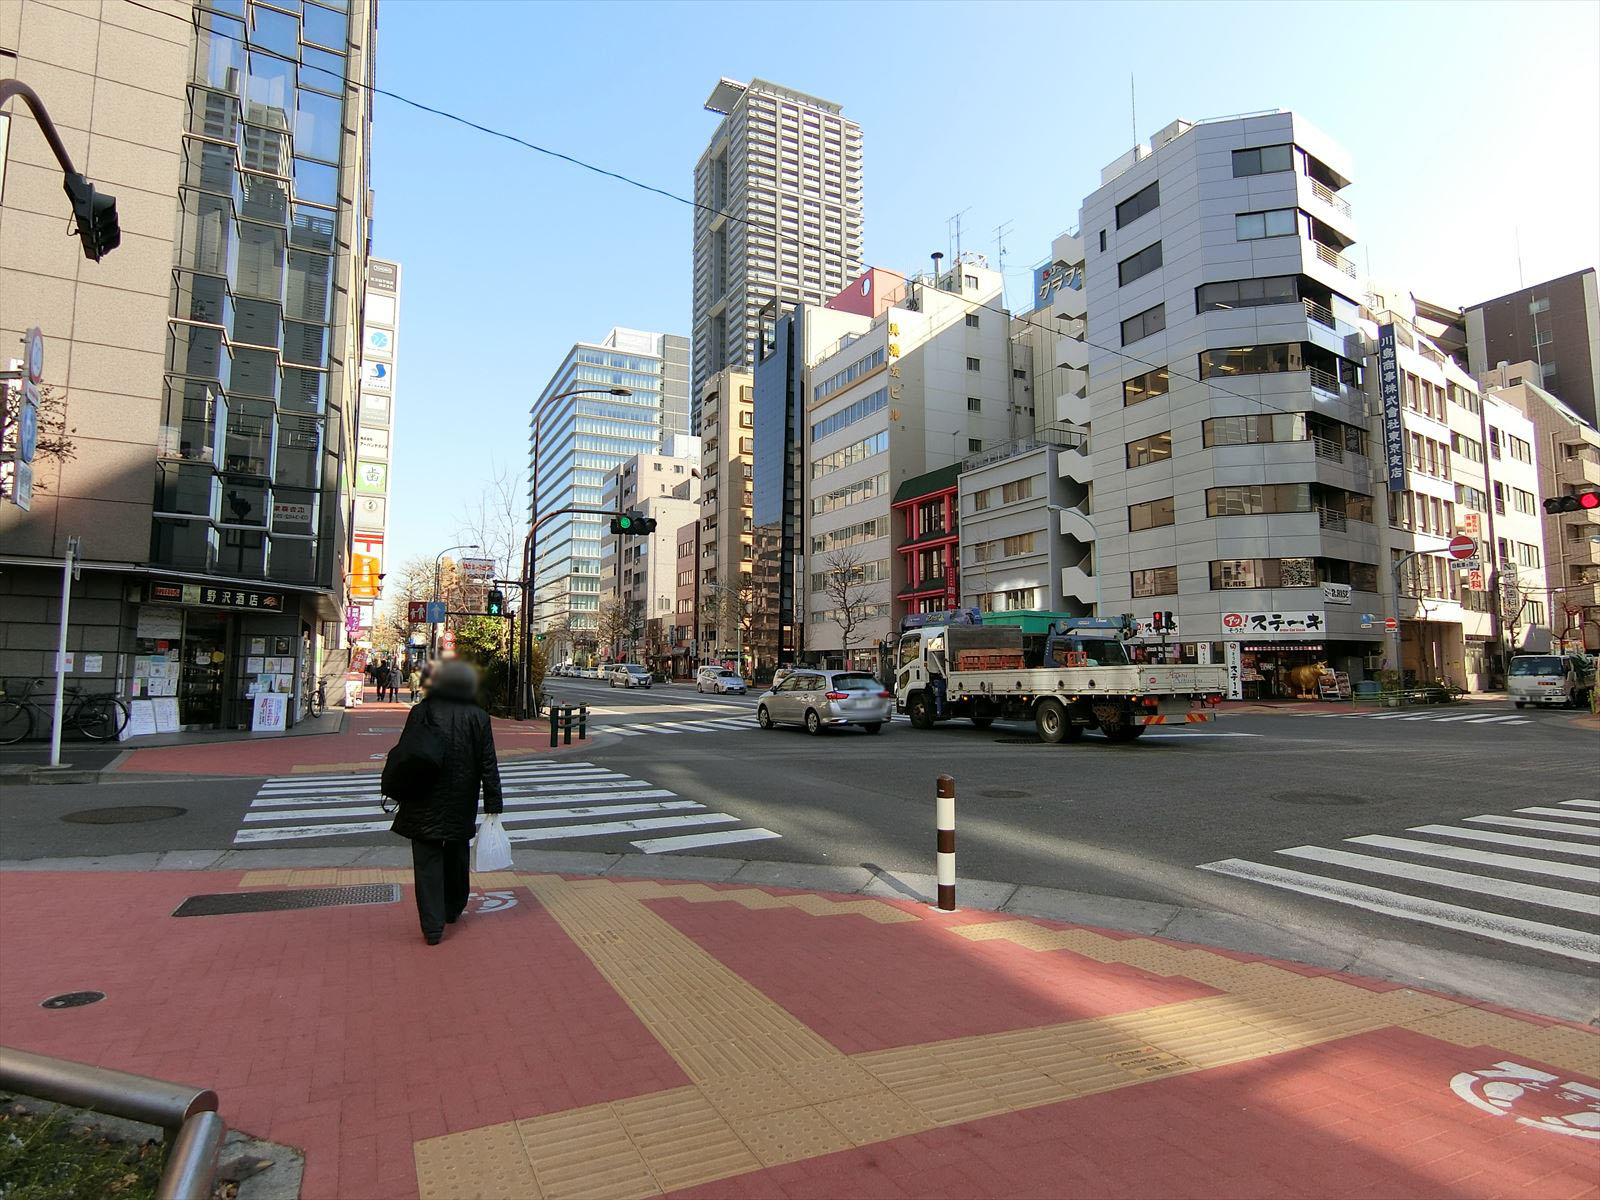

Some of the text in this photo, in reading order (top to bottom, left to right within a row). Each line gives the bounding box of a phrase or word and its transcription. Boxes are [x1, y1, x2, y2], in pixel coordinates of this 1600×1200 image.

[1381, 335, 1403, 479] 川島商事株式會社東京支店
[206, 589, 259, 607] 野沢酒店
[1250, 613, 1323, 631] ステーキ
[1230, 665, 1239, 697] ステーキ
